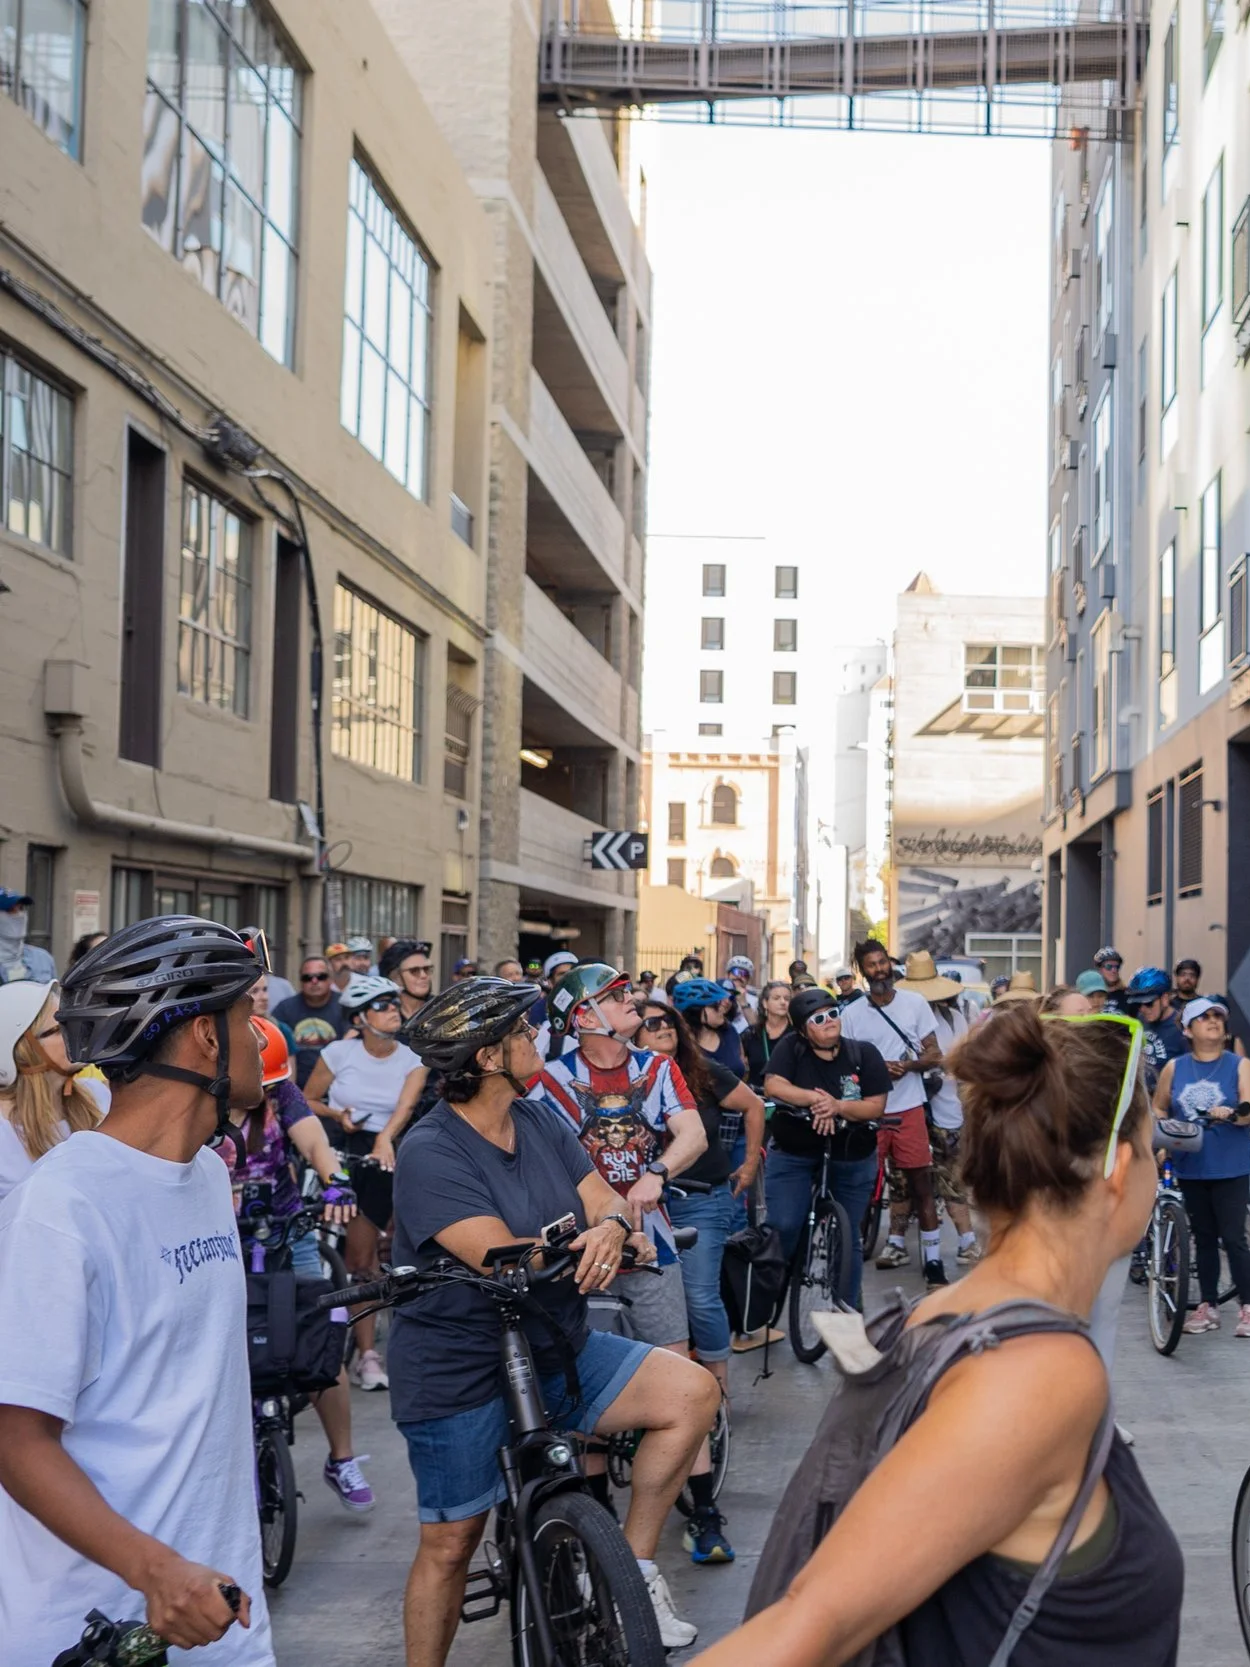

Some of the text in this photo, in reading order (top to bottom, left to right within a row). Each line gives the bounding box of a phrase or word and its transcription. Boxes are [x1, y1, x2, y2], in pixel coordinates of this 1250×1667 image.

[631, 842, 644, 860] P
[154, 968, 194, 982] GIRO
[601, 1150, 639, 1165] RUN
[606, 1168, 637, 1183] DIE
